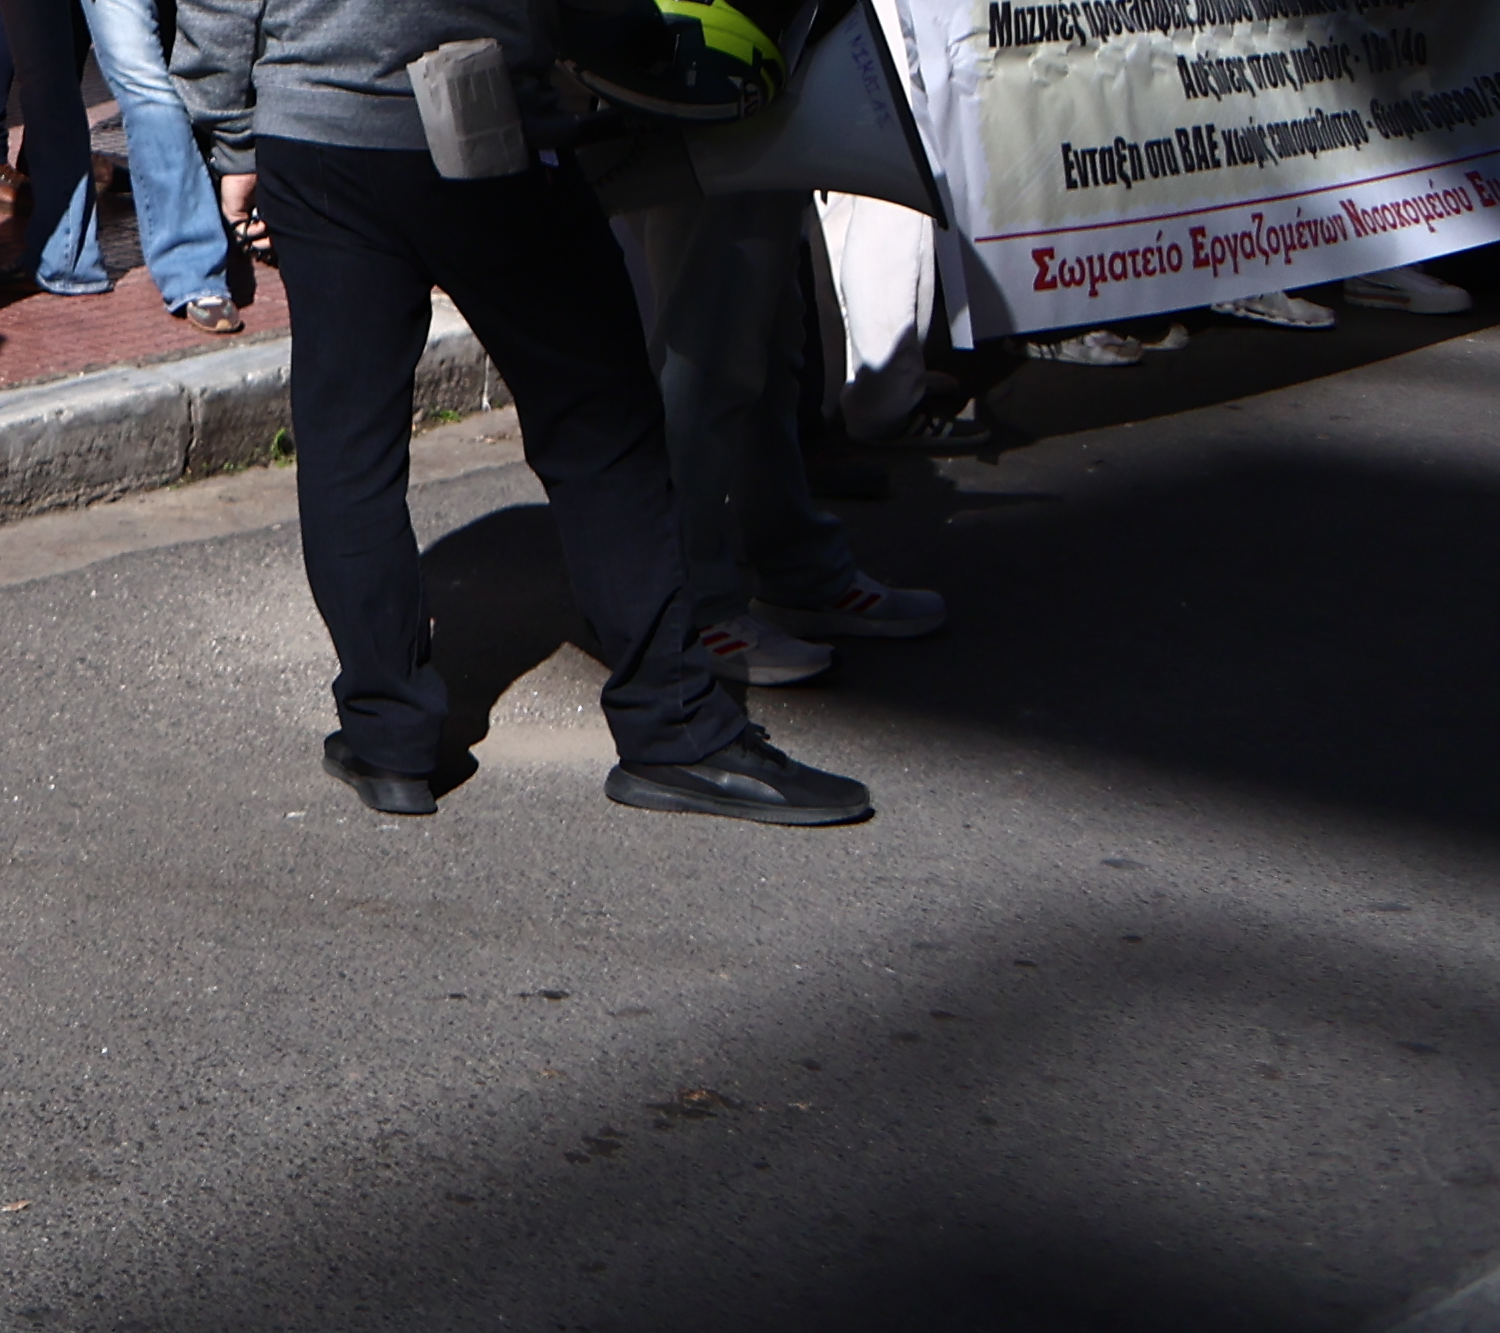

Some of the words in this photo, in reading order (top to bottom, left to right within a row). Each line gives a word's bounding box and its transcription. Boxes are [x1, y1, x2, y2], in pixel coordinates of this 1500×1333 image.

[1174, 123, 1222, 174] ΒΑΕ
[1031, 229, 1184, 299] Σωματείο
[1189, 207, 1348, 278] Εργαζομένων
[1339, 178, 1475, 238] Νοσοκομείου
